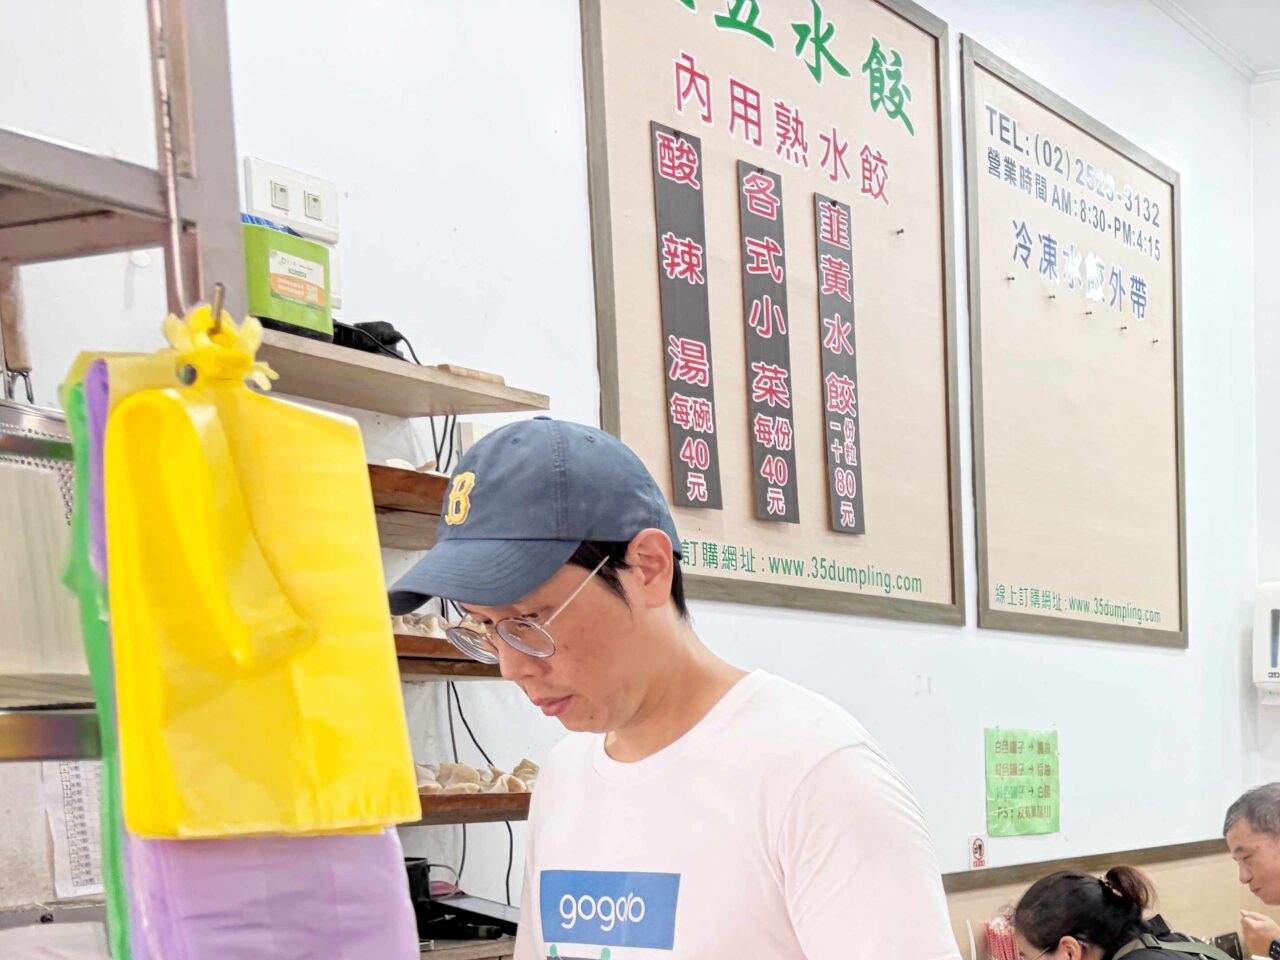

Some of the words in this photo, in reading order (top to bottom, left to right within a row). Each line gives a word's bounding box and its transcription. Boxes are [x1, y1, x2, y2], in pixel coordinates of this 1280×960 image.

[676, 0, 914, 136] 五水餃
[1012, 219, 1147, 320] 冷凍水外帶
[445, 471, 475, 525] B
